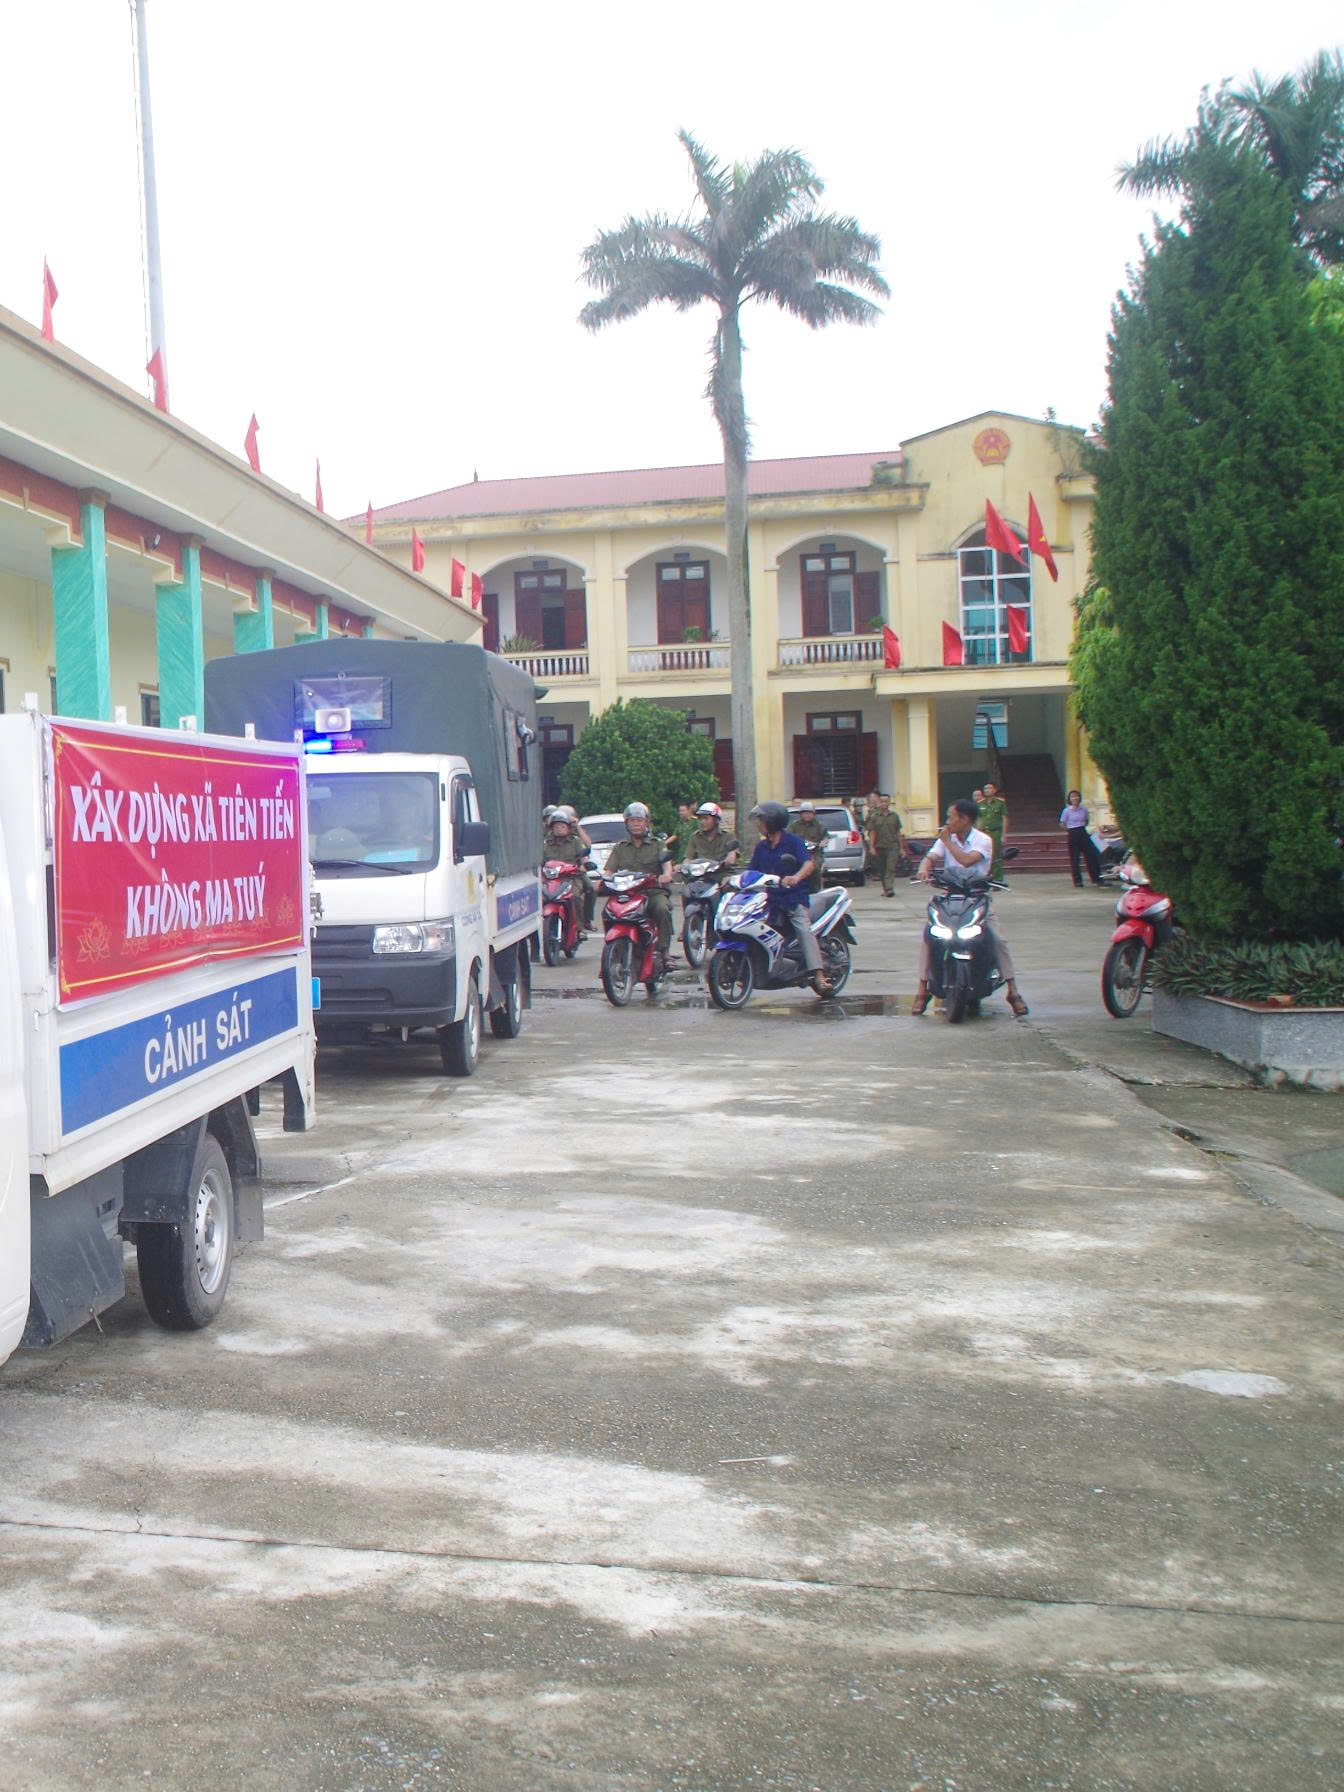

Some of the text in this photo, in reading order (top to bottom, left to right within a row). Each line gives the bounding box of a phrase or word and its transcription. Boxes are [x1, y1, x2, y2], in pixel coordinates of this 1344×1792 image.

[70, 771, 294, 859] XÂY DỰNG XÃ TIÊN TIẾN
[126, 861, 266, 939] KHÔNG MA TUÝ
[145, 991, 252, 1084] CẢNH SÁT
